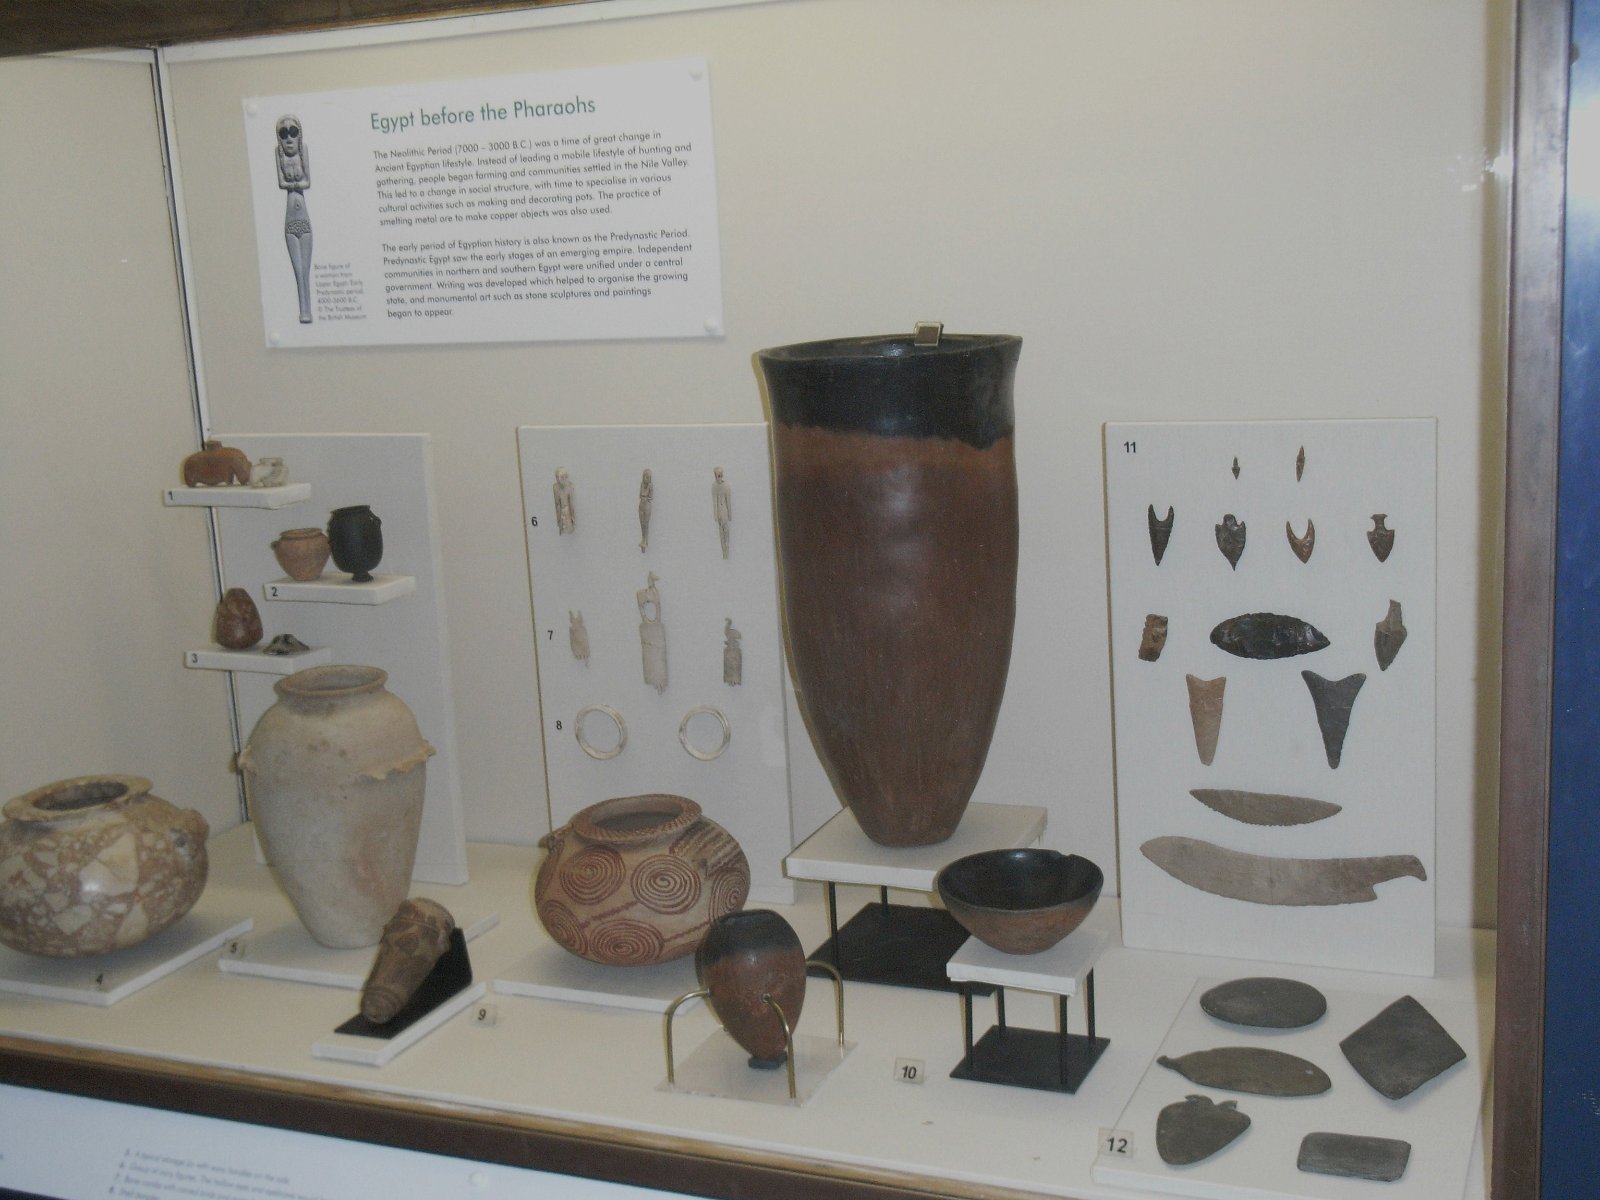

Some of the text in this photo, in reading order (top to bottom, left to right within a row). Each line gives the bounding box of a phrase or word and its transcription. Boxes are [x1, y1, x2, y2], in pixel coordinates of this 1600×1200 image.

[370, 96, 596, 134] Egypt before the Pharaohs
[374, 150, 388, 159] The
[390, 147, 425, 158] Neolithic
[428, 146, 452, 156] Period
[489, 141, 509, 150] 3000
[562, 137, 579, 145] time
[582, 135, 591, 144] of
[594, 133, 616, 145] great
[619, 131, 650, 142] change
[653, 131, 661, 139] in
[375, 162, 404, 173] Ancient
[406, 160, 440, 172] Egyptian
[478, 155, 507, 165] Instead
[510, 154, 518, 163] of
[520, 153, 551, 164] leading
[562, 149, 590, 159] mobile
[593, 147, 624, 158] lifestyle
[628, 146, 636, 154] of
[639, 143, 671, 154] hunting
[675, 142, 692, 152] and
[419, 173, 445, 184] people
[448, 171, 473, 181] began
[476, 168, 507, 180] farming
[510, 169, 526, 177] and
[528, 165, 581, 177] communities
[583, 163, 611, 173] settled
[614, 161, 621, 170] in
[625, 160, 638, 169] the
[641, 159, 659, 168] Nile
[378, 190, 392, 199] This
[395, 188, 407, 198] led
[410, 188, 417, 197] to
[428, 185, 456, 197] change
[459, 184, 466, 193] in
[469, 183, 491, 193] social
[494, 181, 532, 192] structure,
[535, 180, 551, 189] with
[555, 178, 572, 188] time
[576, 179, 583, 187] to
[587, 176, 627, 187] specialise
[630, 175, 638, 183] in
[640, 173, 672, 183] various
[379, 202, 407, 212] cultural
[410, 199, 443, 210] activities
[446, 198, 463, 208] such
[478, 196, 508, 207] making
[511, 196, 526, 205] and
[529, 192, 572, 205] decorating
[598, 190, 613, 199] The
[616, 188, 650, 200] practice
[653, 187, 662, 197] of
[379, 215, 412, 226] smelting
[415, 213, 437, 223] metal
[455, 211, 463, 221] to
[465, 211, 488, 221] make
[490, 211, 518, 221] copper
[521, 207, 549, 219] objects
[571, 207, 588, 215] also
[382, 243, 396, 252] The
[399, 243, 417, 253] early
[421, 241, 445, 252] period
[448, 240, 456, 249] of
[458, 240, 493, 250] Egyptian
[495, 237, 521, 248] history
[524, 236, 530, 245] is
[533, 236, 550, 245] also
[553, 234, 580, 244] known
[595, 233, 608, 242] the
[610, 231, 658, 242] Predynastic
[383, 257, 427, 266] Predynastic
[429, 255, 451, 265] Egypt
[471, 253, 484, 262] the
[486, 252, 505, 262] early
[508, 252, 534, 262] stages
[536, 250, 545, 259] of
[560, 247, 600, 258] emerging
[603, 247, 634, 256] empire.
[638, 244, 692, 254] Independent
[384, 269, 433, 278] communities
[436, 268, 444, 277] in
[446, 267, 480, 276] northern
[482, 266, 497, 274] and
[500, 265, 536, 274] southern
[539, 263, 561, 274] Egypt
[587, 259, 615, 269] unified
[618, 259, 643, 268] under
[654, 258, 683, 267] central
[437, 281, 466, 291] Writing
[485, 278, 527, 289] developed
[530, 274, 553, 285] which
[556, 274, 585, 285] helped
[587, 274, 595, 283] to
[598, 274, 635, 285] organise
[637, 272, 651, 281] the
[653, 271, 689, 282] growing
[386, 297, 408, 305] state,
[410, 295, 425, 304] and
[427, 293, 478, 303] monumental
[480, 293, 491, 301] art
[493, 291, 512, 301] such
[526, 290, 548, 299] stone
[550, 289, 592, 299] sculptures
[594, 288, 610, 297] and
[613, 287, 652, 297] paintings
[387, 309, 412, 319] began
[415, 309, 422, 317] to
[1124, 441, 1137, 453] 11
[168, 491, 173, 500] 1
[531, 517, 538, 526] 6
[272, 587, 278, 597] 2
[547, 630, 553, 640] 7
[192, 653, 198, 664] 3
[556, 720, 562, 730] 8
[478, 1008, 486, 1021] 9
[902, 1065, 917, 1079] 10
[1106, 1137, 1128, 1153] 12
